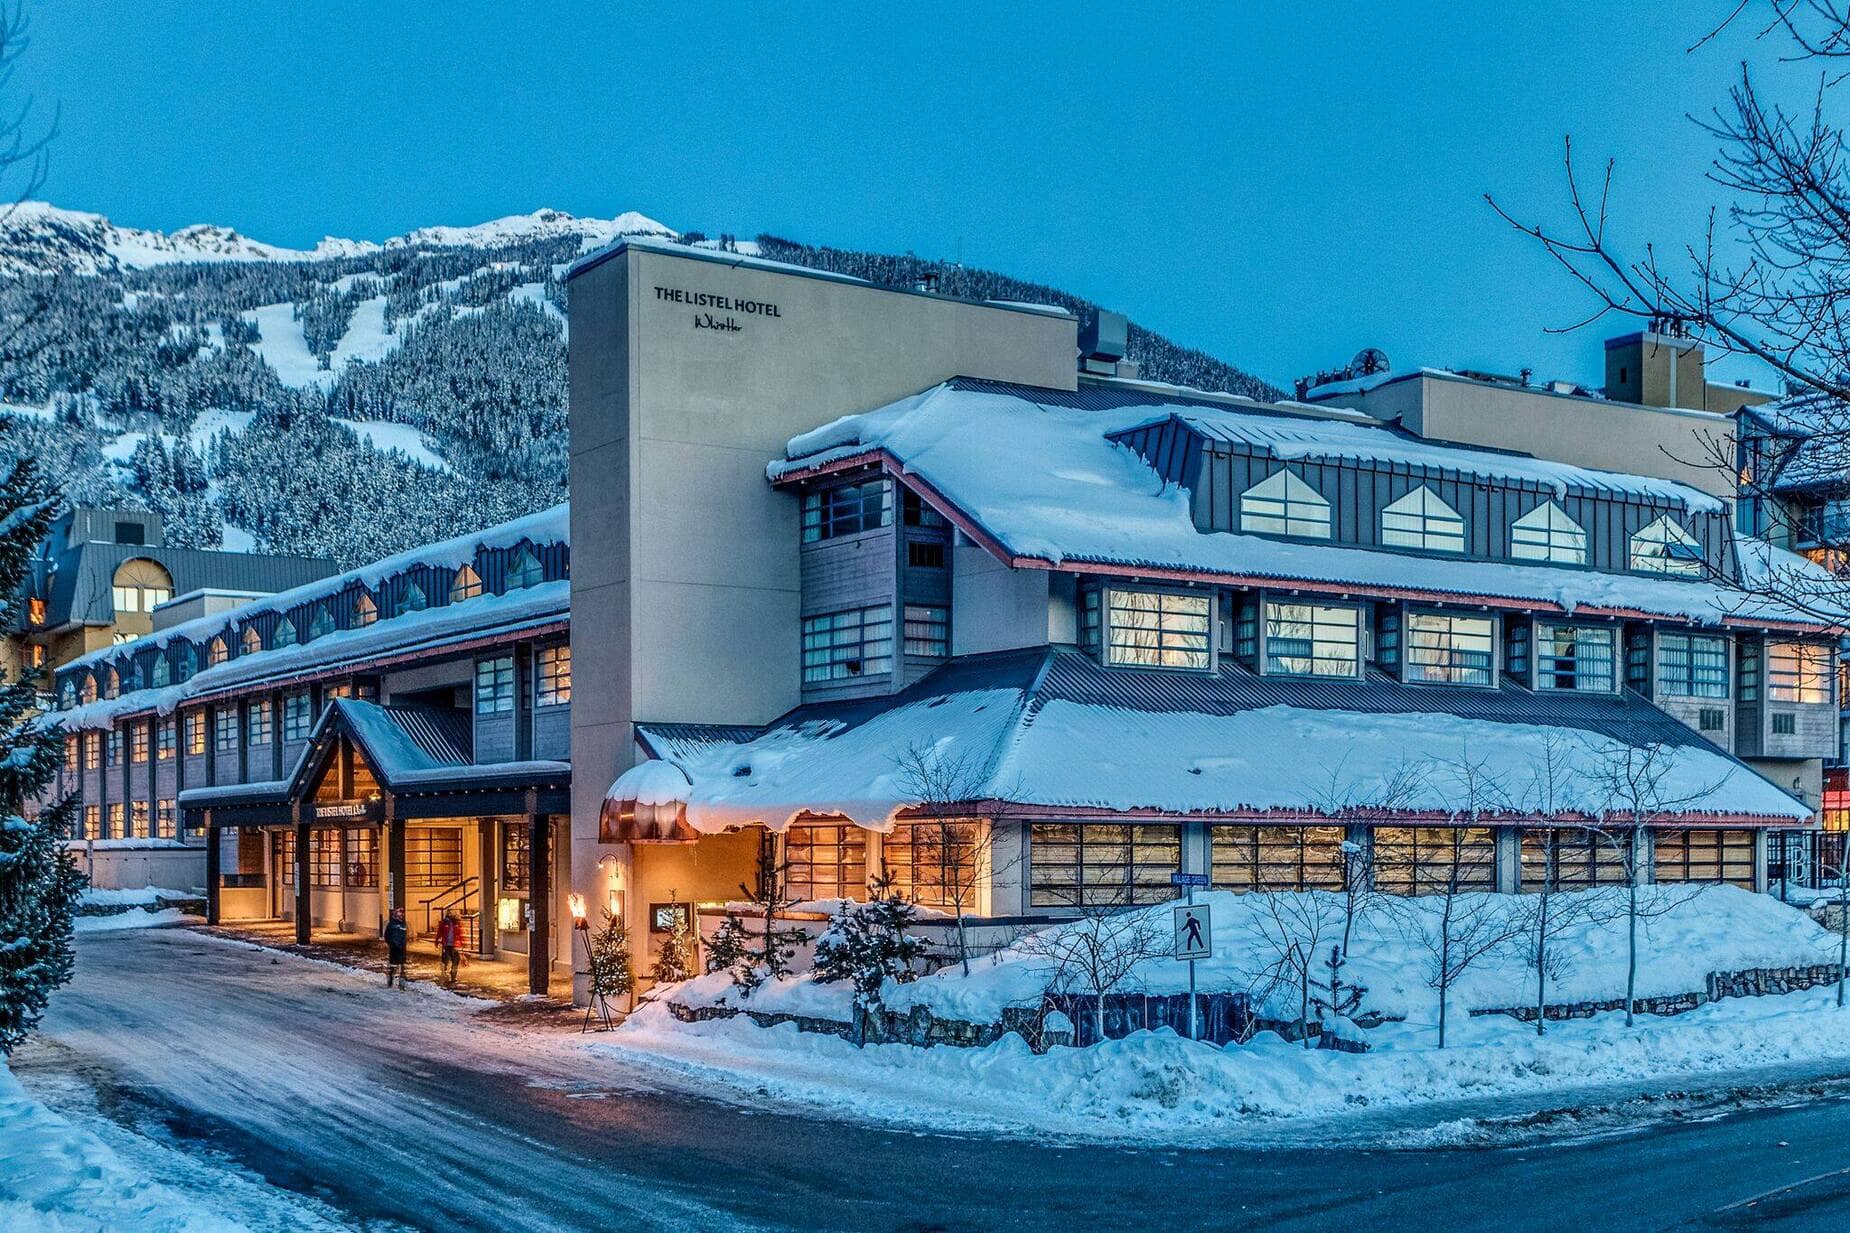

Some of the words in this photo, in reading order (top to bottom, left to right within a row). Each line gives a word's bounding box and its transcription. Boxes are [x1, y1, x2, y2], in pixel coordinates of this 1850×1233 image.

[654, 286, 682, 303] THE
[685, 291, 733, 310] LISTEL
[734, 299, 782, 318] HOTEL
